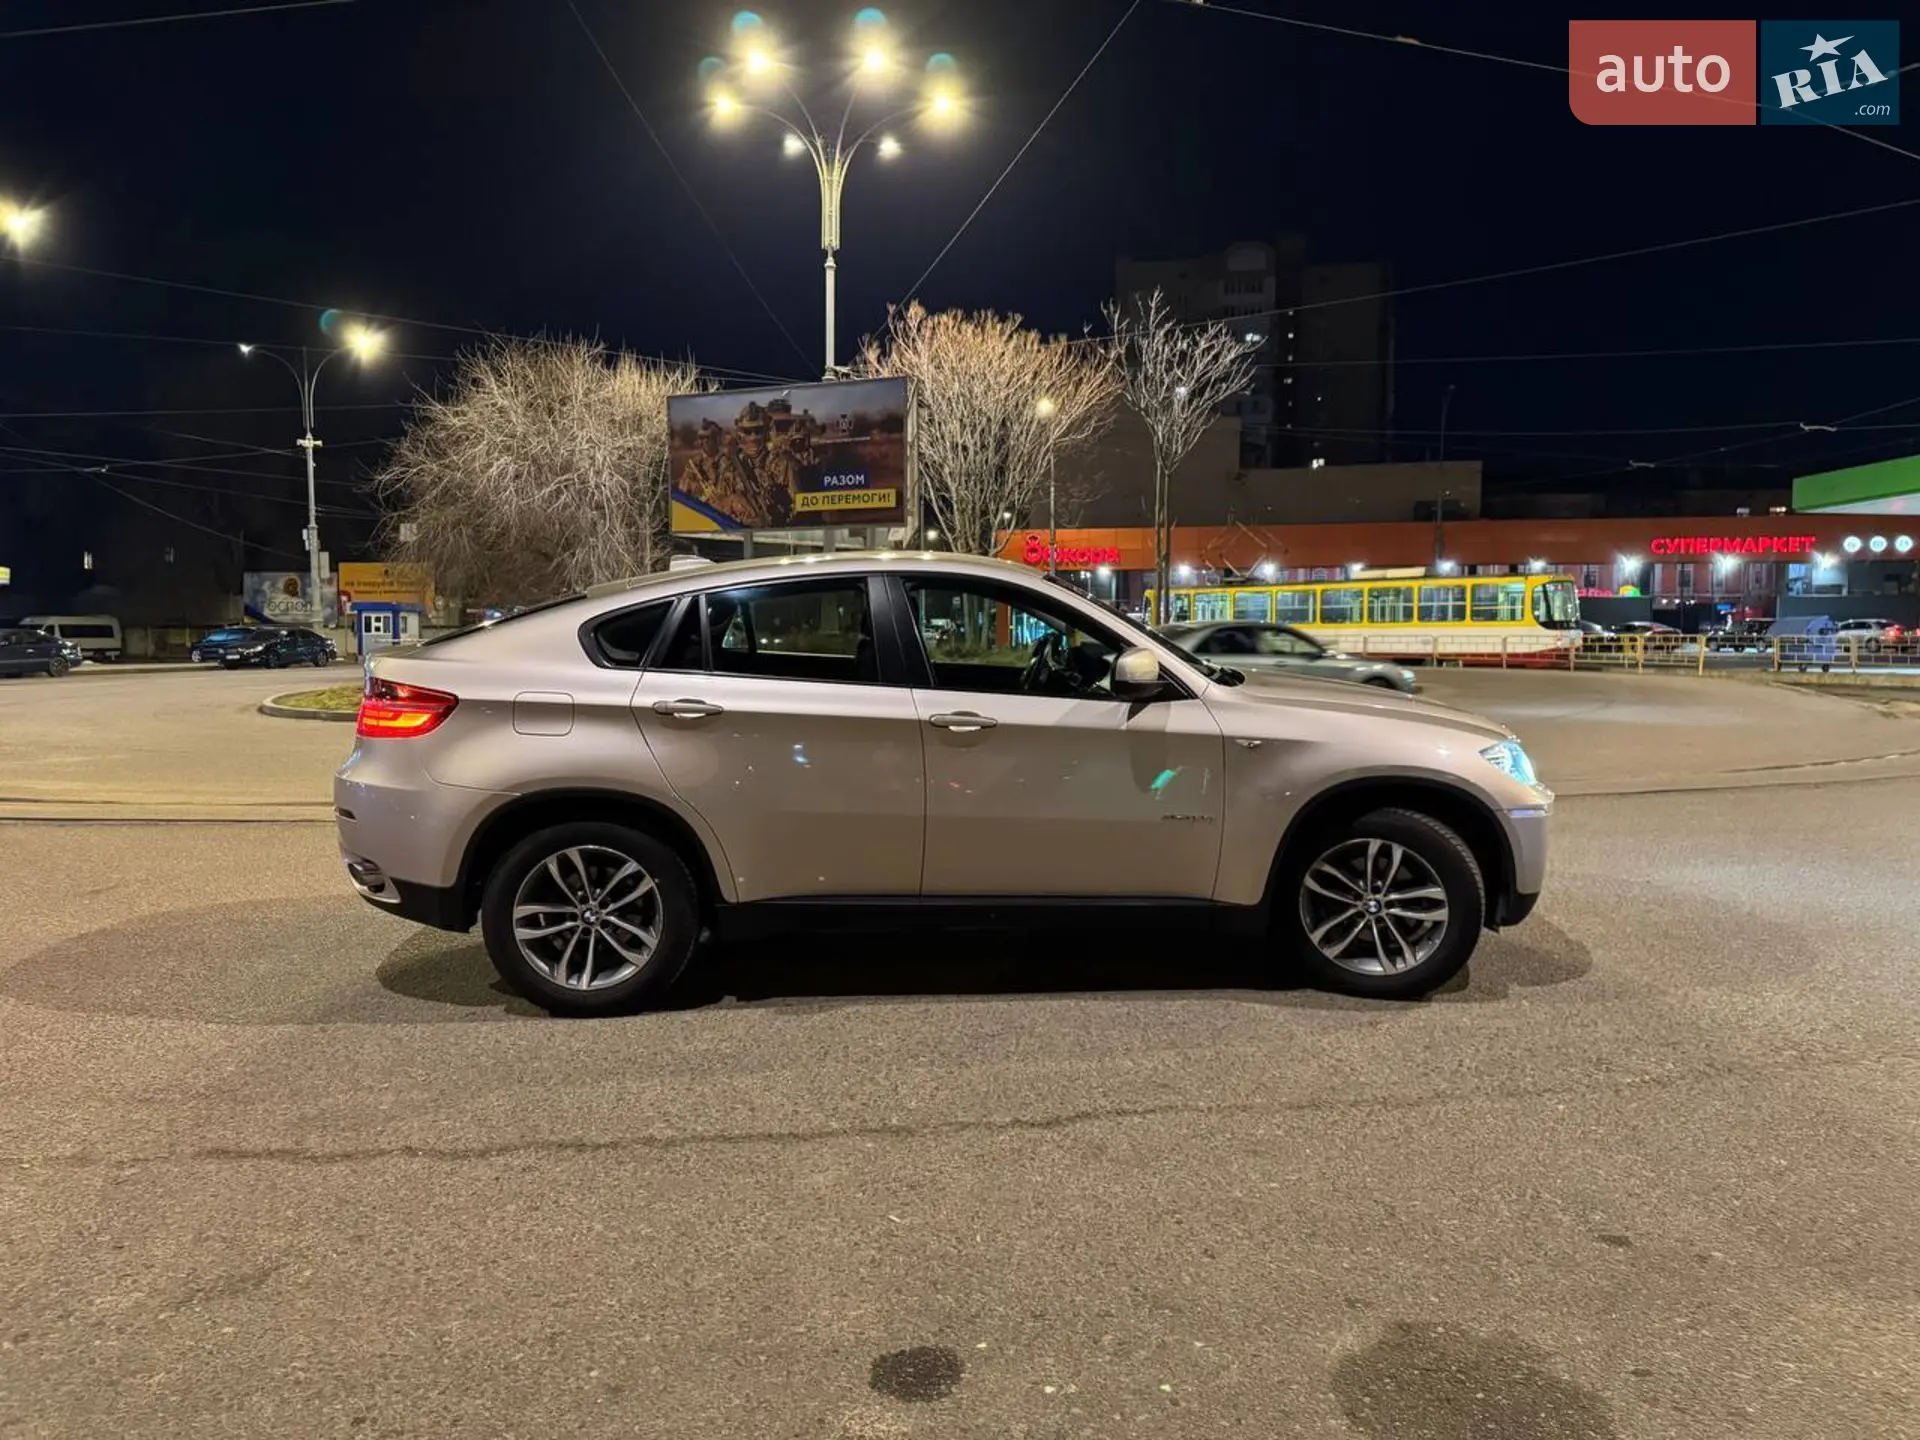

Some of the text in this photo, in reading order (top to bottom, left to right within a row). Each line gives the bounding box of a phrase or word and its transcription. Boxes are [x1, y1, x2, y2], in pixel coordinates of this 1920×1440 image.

[823, 474, 866, 487] РАЗОМ
[801, 493, 891, 508] ДО ПЕРЕМОГИ!
[1650, 535, 1817, 555] СУПЕРМАРКЕТ
